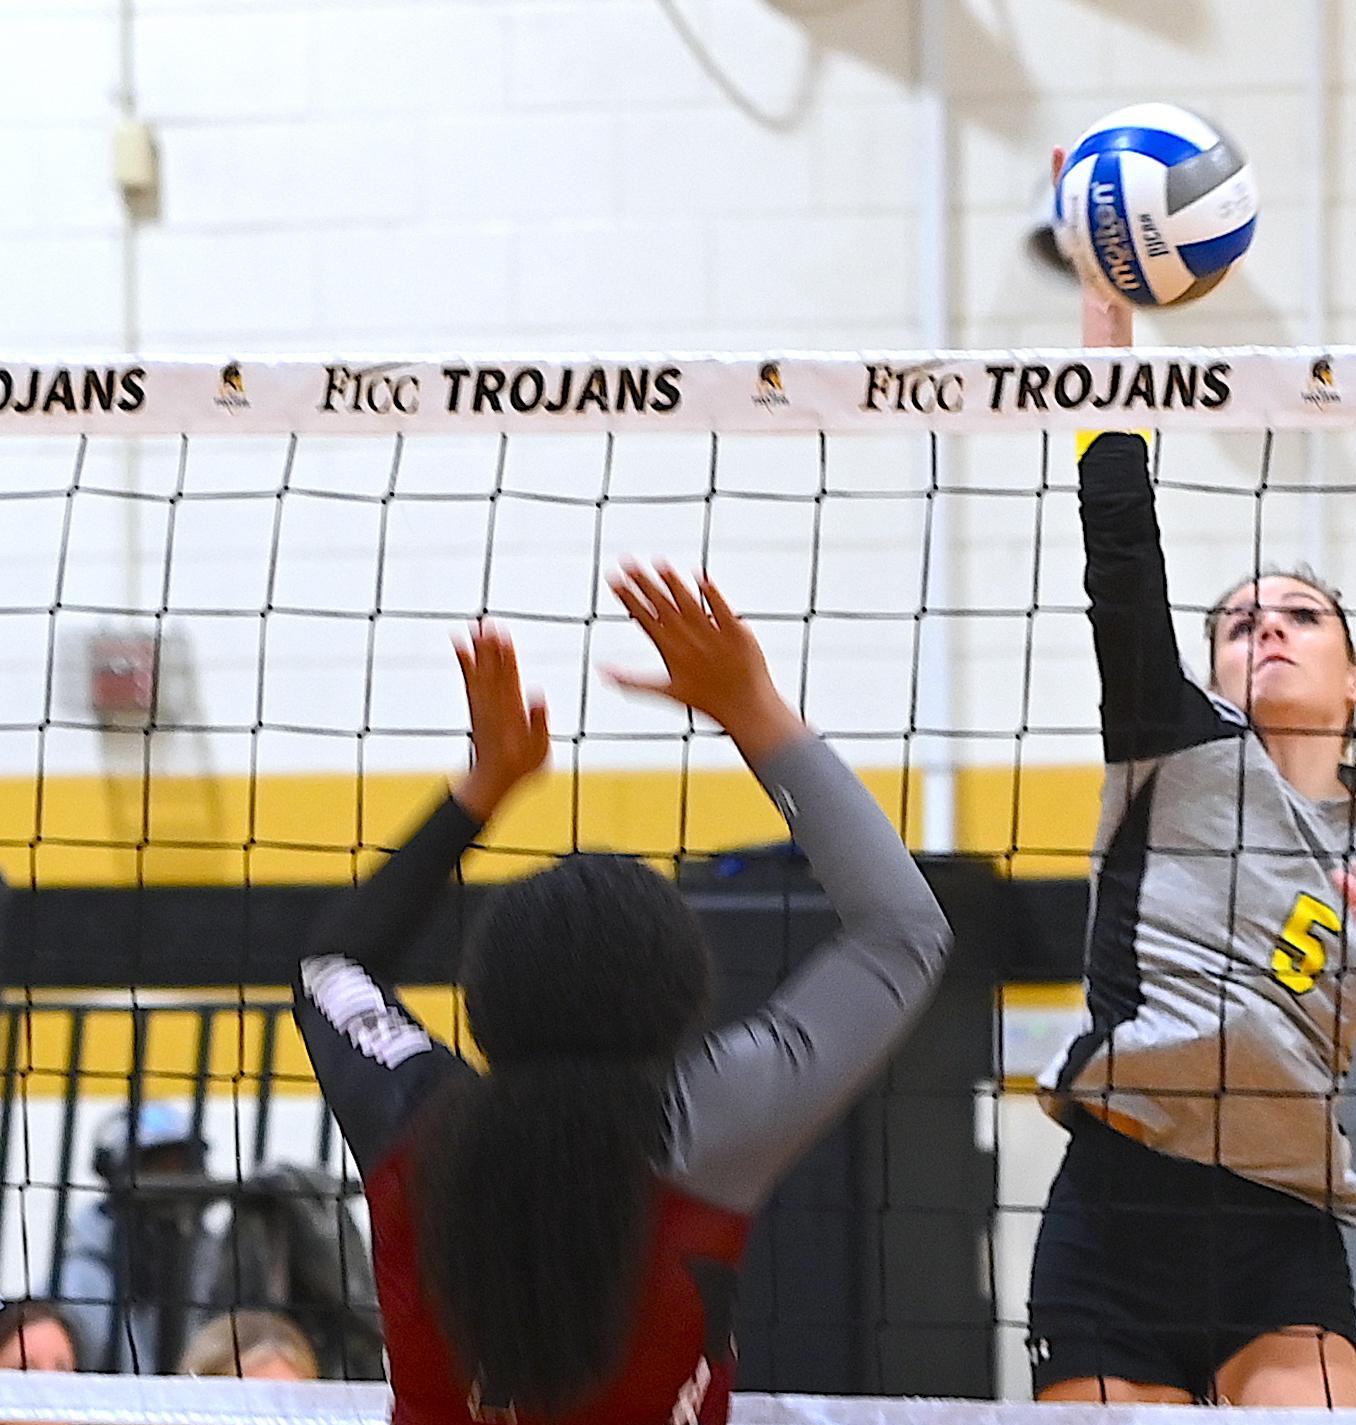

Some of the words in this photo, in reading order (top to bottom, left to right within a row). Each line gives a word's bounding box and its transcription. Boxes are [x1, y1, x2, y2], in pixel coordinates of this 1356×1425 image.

[441, 364, 683, 414] TROJANS
[984, 361, 1233, 412] TROJANS
[1270, 890, 1343, 997] 5
